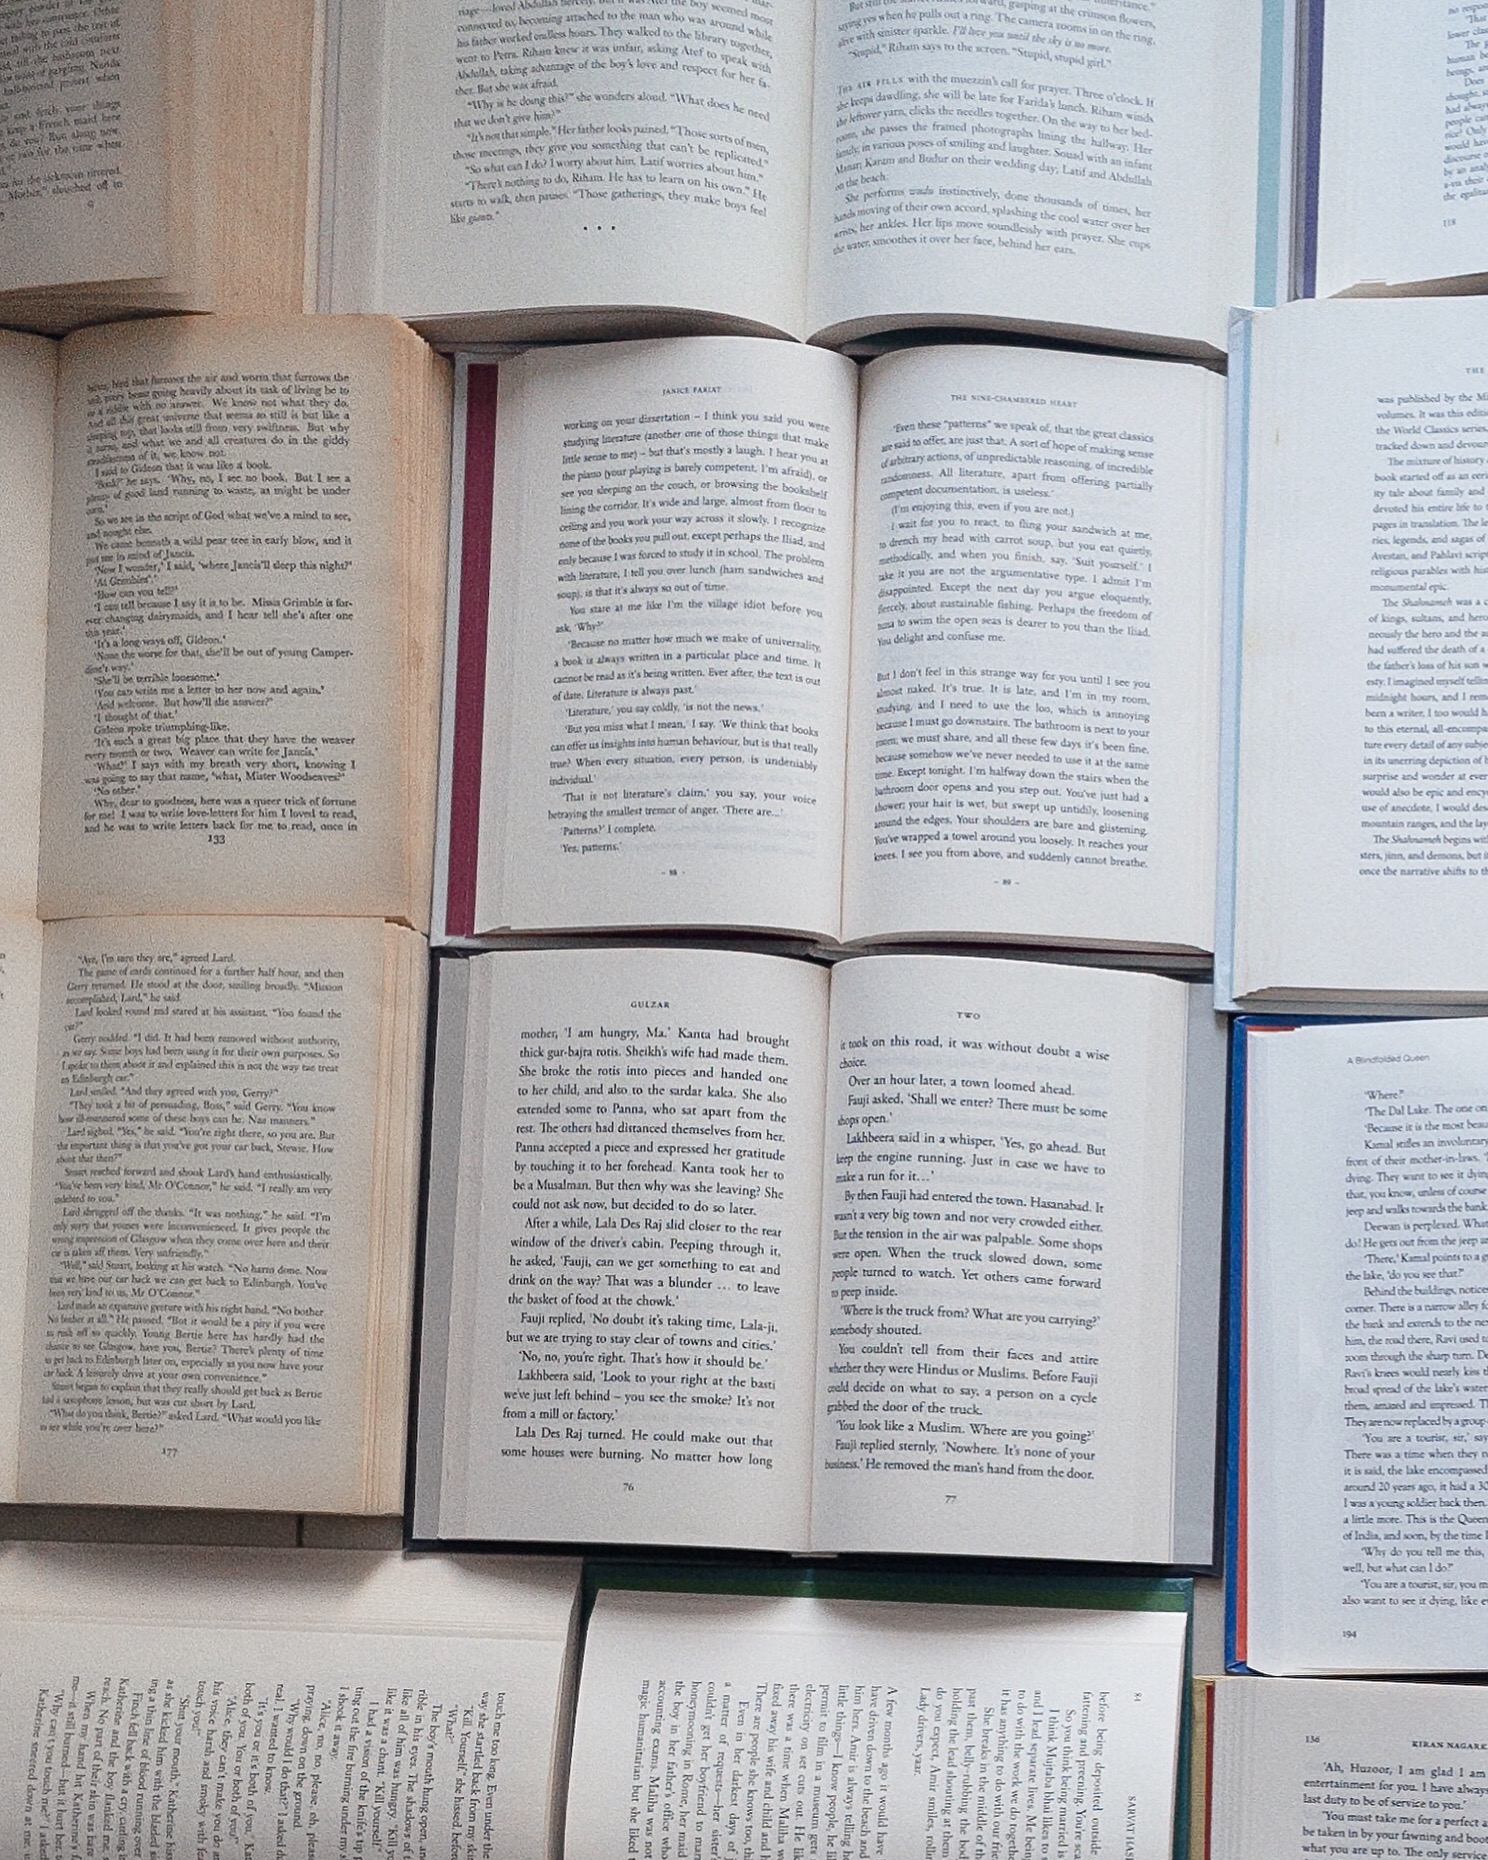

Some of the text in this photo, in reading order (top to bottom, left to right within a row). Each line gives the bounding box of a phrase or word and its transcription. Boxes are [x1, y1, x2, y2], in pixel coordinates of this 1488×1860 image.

[928, 233, 1076, 255] over her face, behind her ears.
[1465, 366, 1485, 374] THE
[662, 385, 722, 396] JANICE PARIAT
[950, 393, 1078, 408] THE NINE-CHAMBERED HEART
[1374, 440, 1409, 451] tracked
[1409, 440, 1436, 451] down
[1437, 439, 1455, 450] and
[207, 833, 226, 845] 133
[873, 846, 1148, 868] knees. I see you from above, and suddenly cannot breathe.
[629, 1000, 670, 1009] GULZAR
[956, 1010, 981, 1020] TWO
[511, 1196, 757, 1216] could not ask now, but decided to do so later.
[161, 1446, 179, 1458] 177
[622, 1481, 635, 1492] 76
[944, 1493, 957, 1504] 77
[1342, 1629, 1357, 1639] 194
[1305, 1734, 1321, 1744] 136
[1411, 1740, 1444, 1749] KIRAN
[1125, 1795, 1137, 1834] SARVAT
